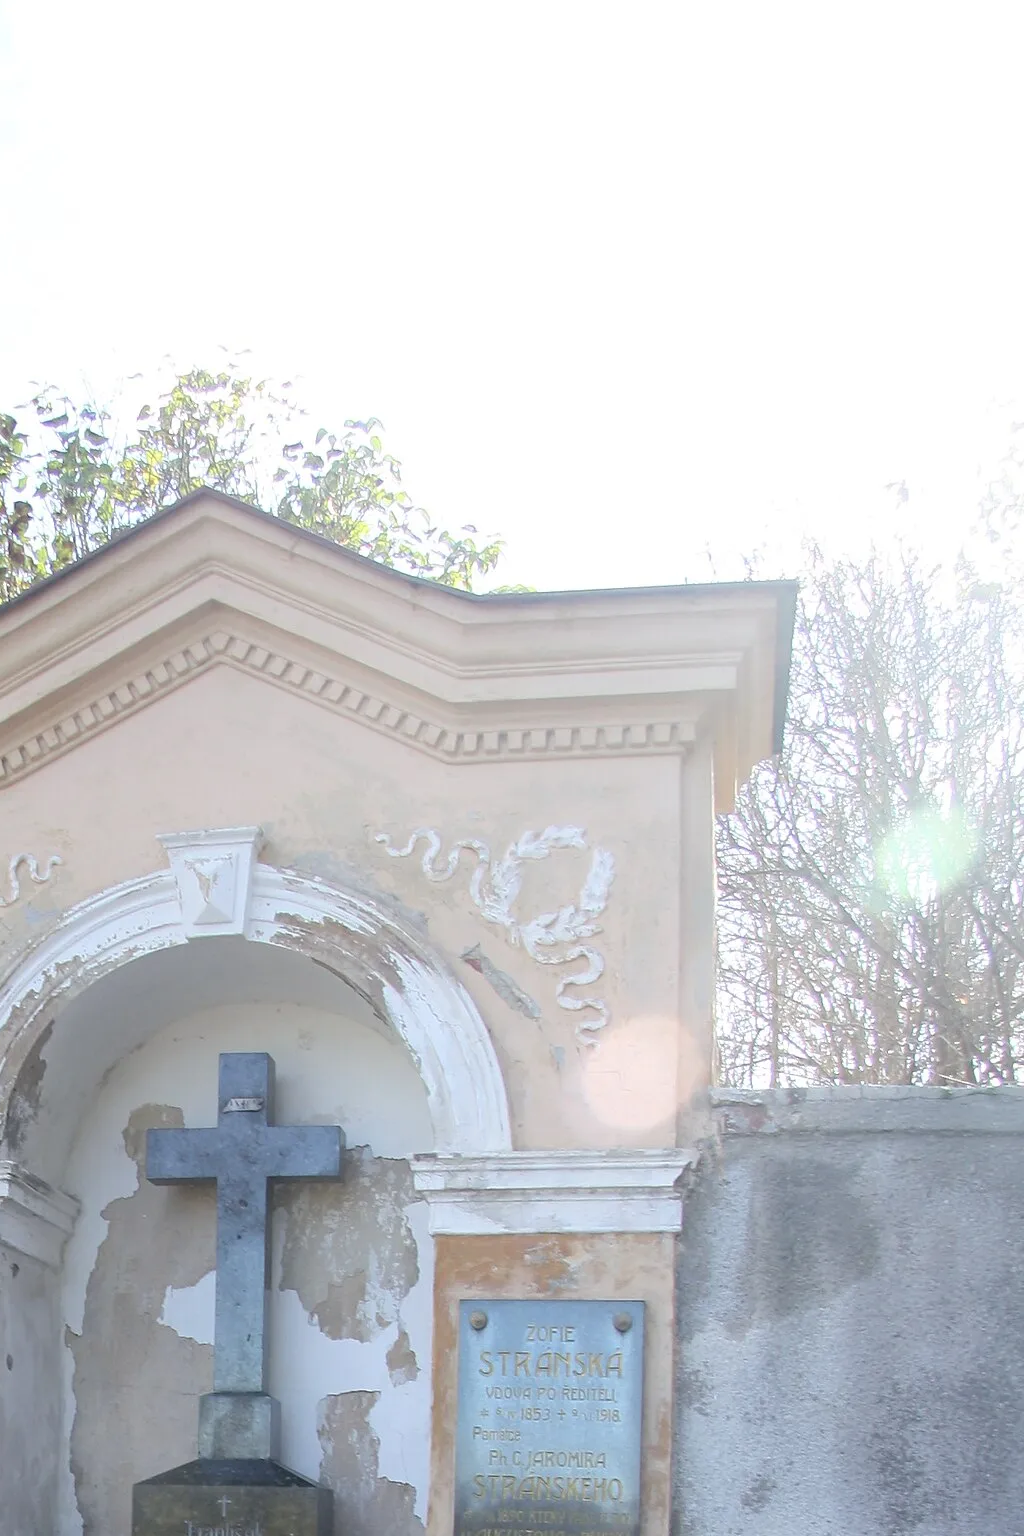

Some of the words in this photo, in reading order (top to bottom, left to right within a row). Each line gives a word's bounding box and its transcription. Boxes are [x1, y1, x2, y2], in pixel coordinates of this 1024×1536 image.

[478, 1346, 624, 1379] STRÁNSKÁ
[485, 1386, 532, 1401] VDOVA
[536, 1387, 557, 1402] PO
